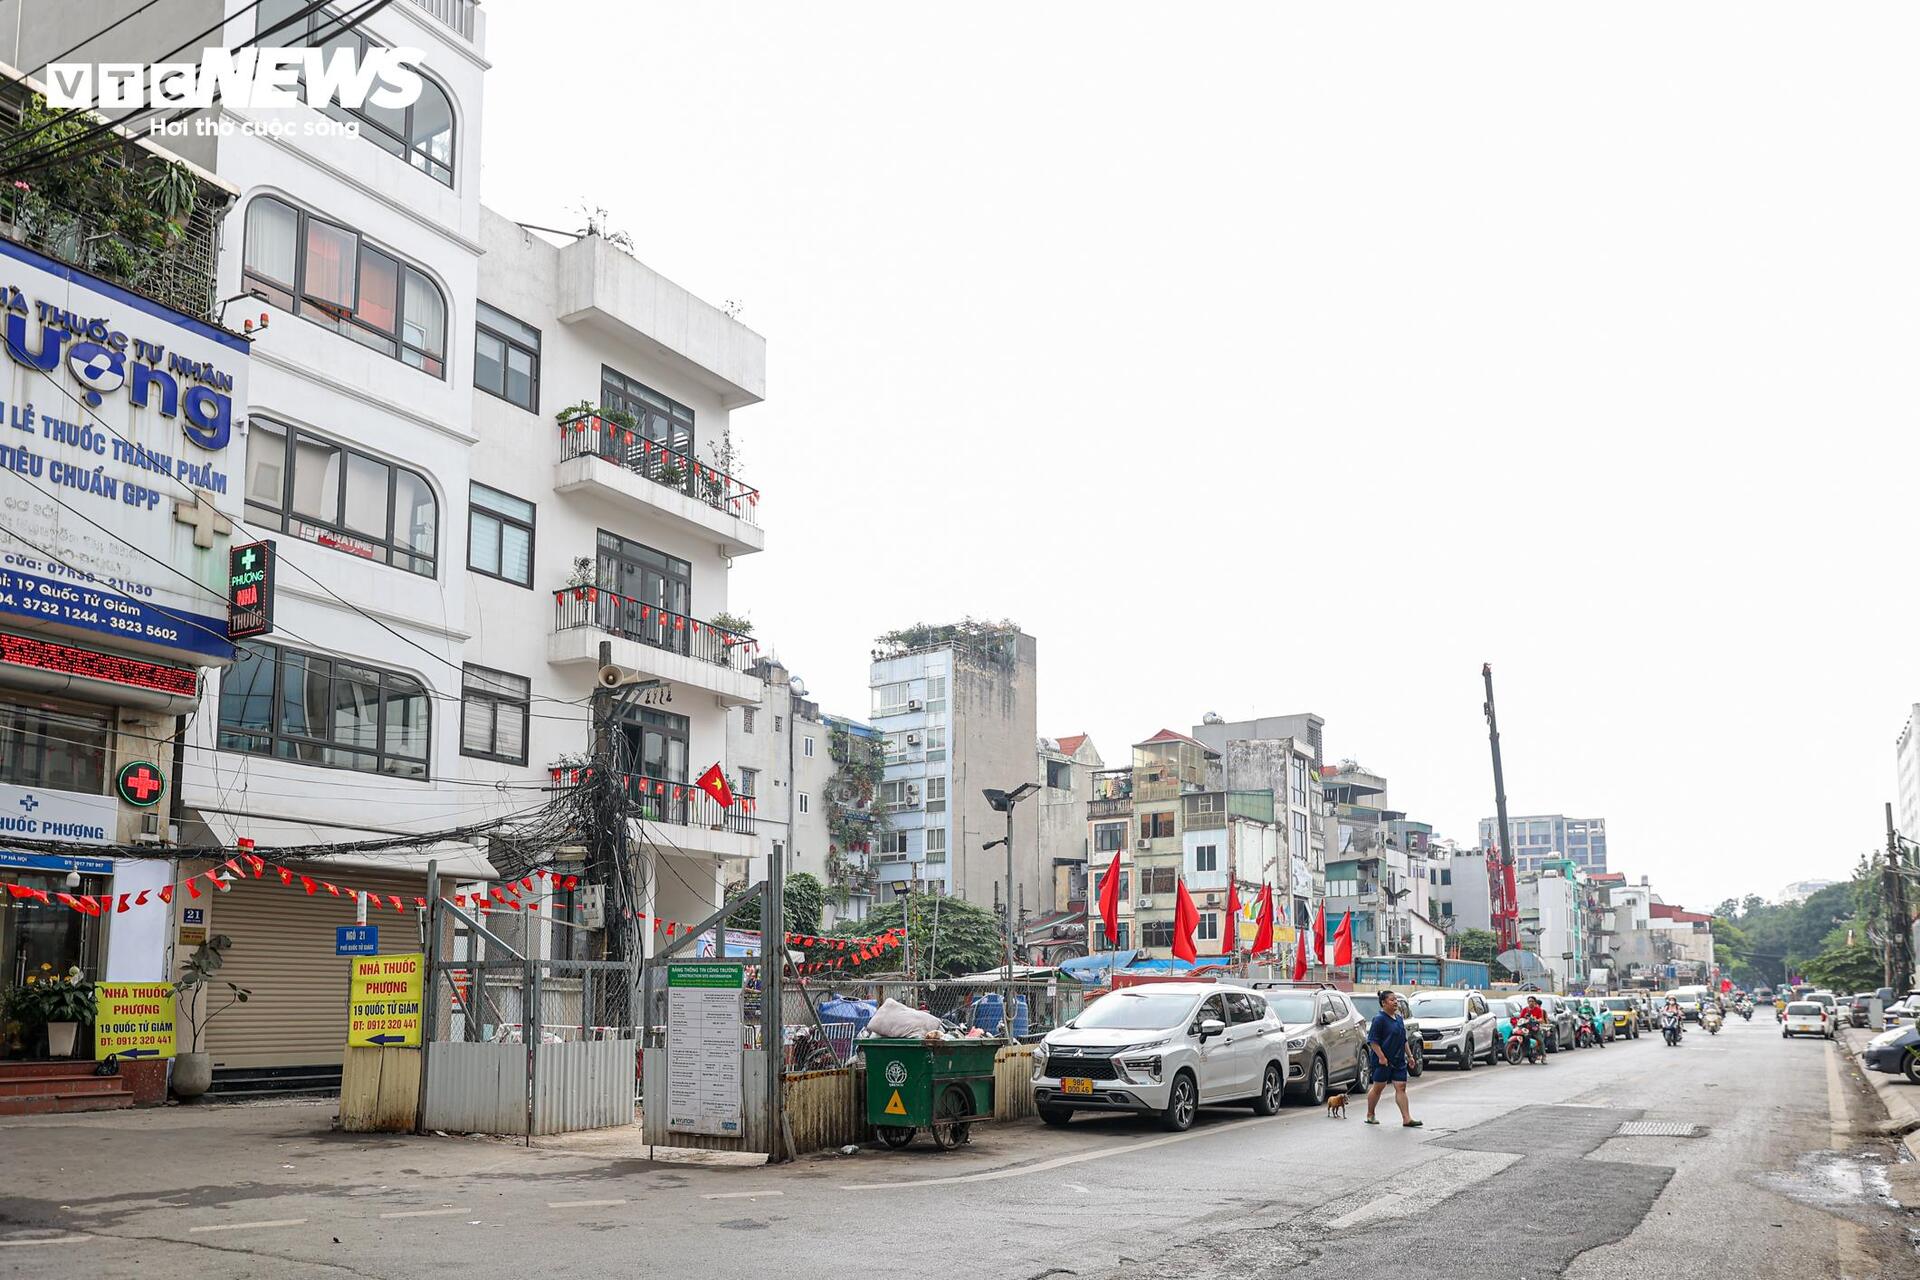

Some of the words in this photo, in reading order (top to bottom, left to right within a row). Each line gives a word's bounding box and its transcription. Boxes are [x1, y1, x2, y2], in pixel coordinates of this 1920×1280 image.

[34, 300, 129, 352] THUỐC
[168, 351, 233, 392] NHÂN
[11, 403, 35, 434] LẺ
[41, 414, 106, 455] THUỐC
[112, 438, 173, 477] THÀNH
[0, 443, 43, 478] TIÊU
[49, 465, 117, 500] CHUẨN
[122, 482, 160, 511] GPP
[4, 554, 42, 570] cửa:
[108, 577, 153, 597] 21h30
[17, 577, 36, 592] 19
[39, 583, 80, 603] Quốc
[83, 593, 101, 607] Tử
[103, 598, 141, 616] Giám
[22, 597, 60, 615] 3732
[64, 605, 99, 624] 1244
[109, 616, 143, 633] 3823
[145, 624, 178, 641] 5602
[232, 605, 263, 632] THUỐC
[42, 821, 104, 840] PHƯỢNG
[187, 910, 200, 919] 21
[360, 961, 380, 975] NHÀ
[384, 957, 416, 974] THUỐC
[105, 987, 129, 998] NHÀ
[132, 985, 168, 998] THUỐC
[366, 980, 408, 996] PHƯỢNG
[113, 1004, 160, 1016] PHƯỢNG
[354, 1005, 363, 1016] 19
[364, 1001, 385, 1016] QUỐC
[387, 1000, 398, 1015] TỬ
[398, 1001, 419, 1014] GIÁM
[100, 1024, 111, 1034] 19
[113, 1020, 136, 1033] QUỐC
[138, 1020, 150, 1032] TỬ
[151, 1022, 173, 1032] GIÁM
[353, 1021, 365, 1031] ĐT:
[367, 1020, 386, 1030] 0912
[387, 1019, 402, 1029] 320
[403, 1019, 417, 1029] 441
[101, 1037, 113, 1046] ĐT:
[117, 1036, 138, 1046] 0912
[140, 1036, 155, 1045] 320
[158, 1035, 172, 1044] 441
